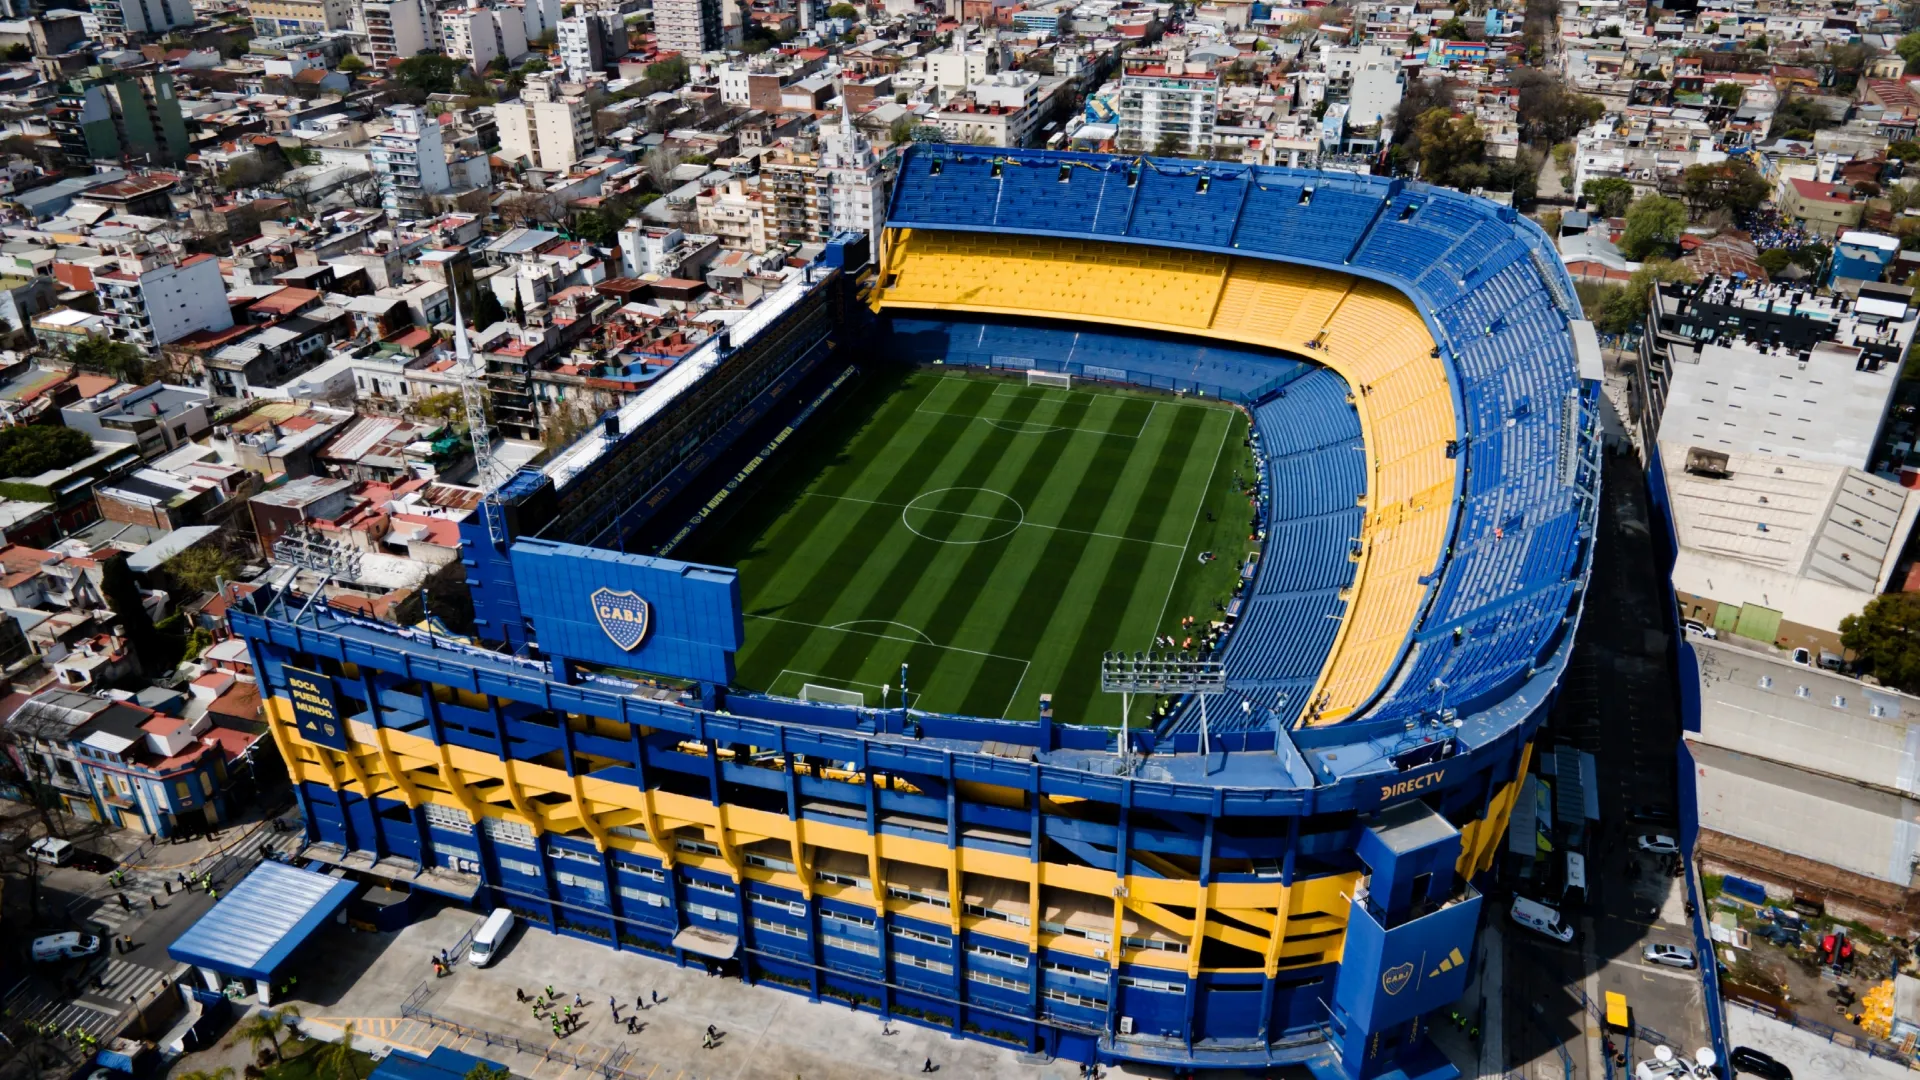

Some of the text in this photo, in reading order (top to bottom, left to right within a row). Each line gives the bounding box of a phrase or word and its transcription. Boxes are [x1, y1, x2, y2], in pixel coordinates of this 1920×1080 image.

[767, 426, 794, 451] LA NUEVA
[734, 456, 764, 483] LA NUEVA
[698, 488, 730, 518] LA NUEVA
[659, 526, 691, 557] BOCA JUNIORS
[600, 606, 642, 624] CABJ
[289, 677, 320, 694] BOCA,
[293, 690, 332, 709] PUEBLO,
[296, 701, 335, 720] MUNDO.
[1380, 769, 1445, 801] DIRECTV
[1386, 971, 1408, 984] CABJ
